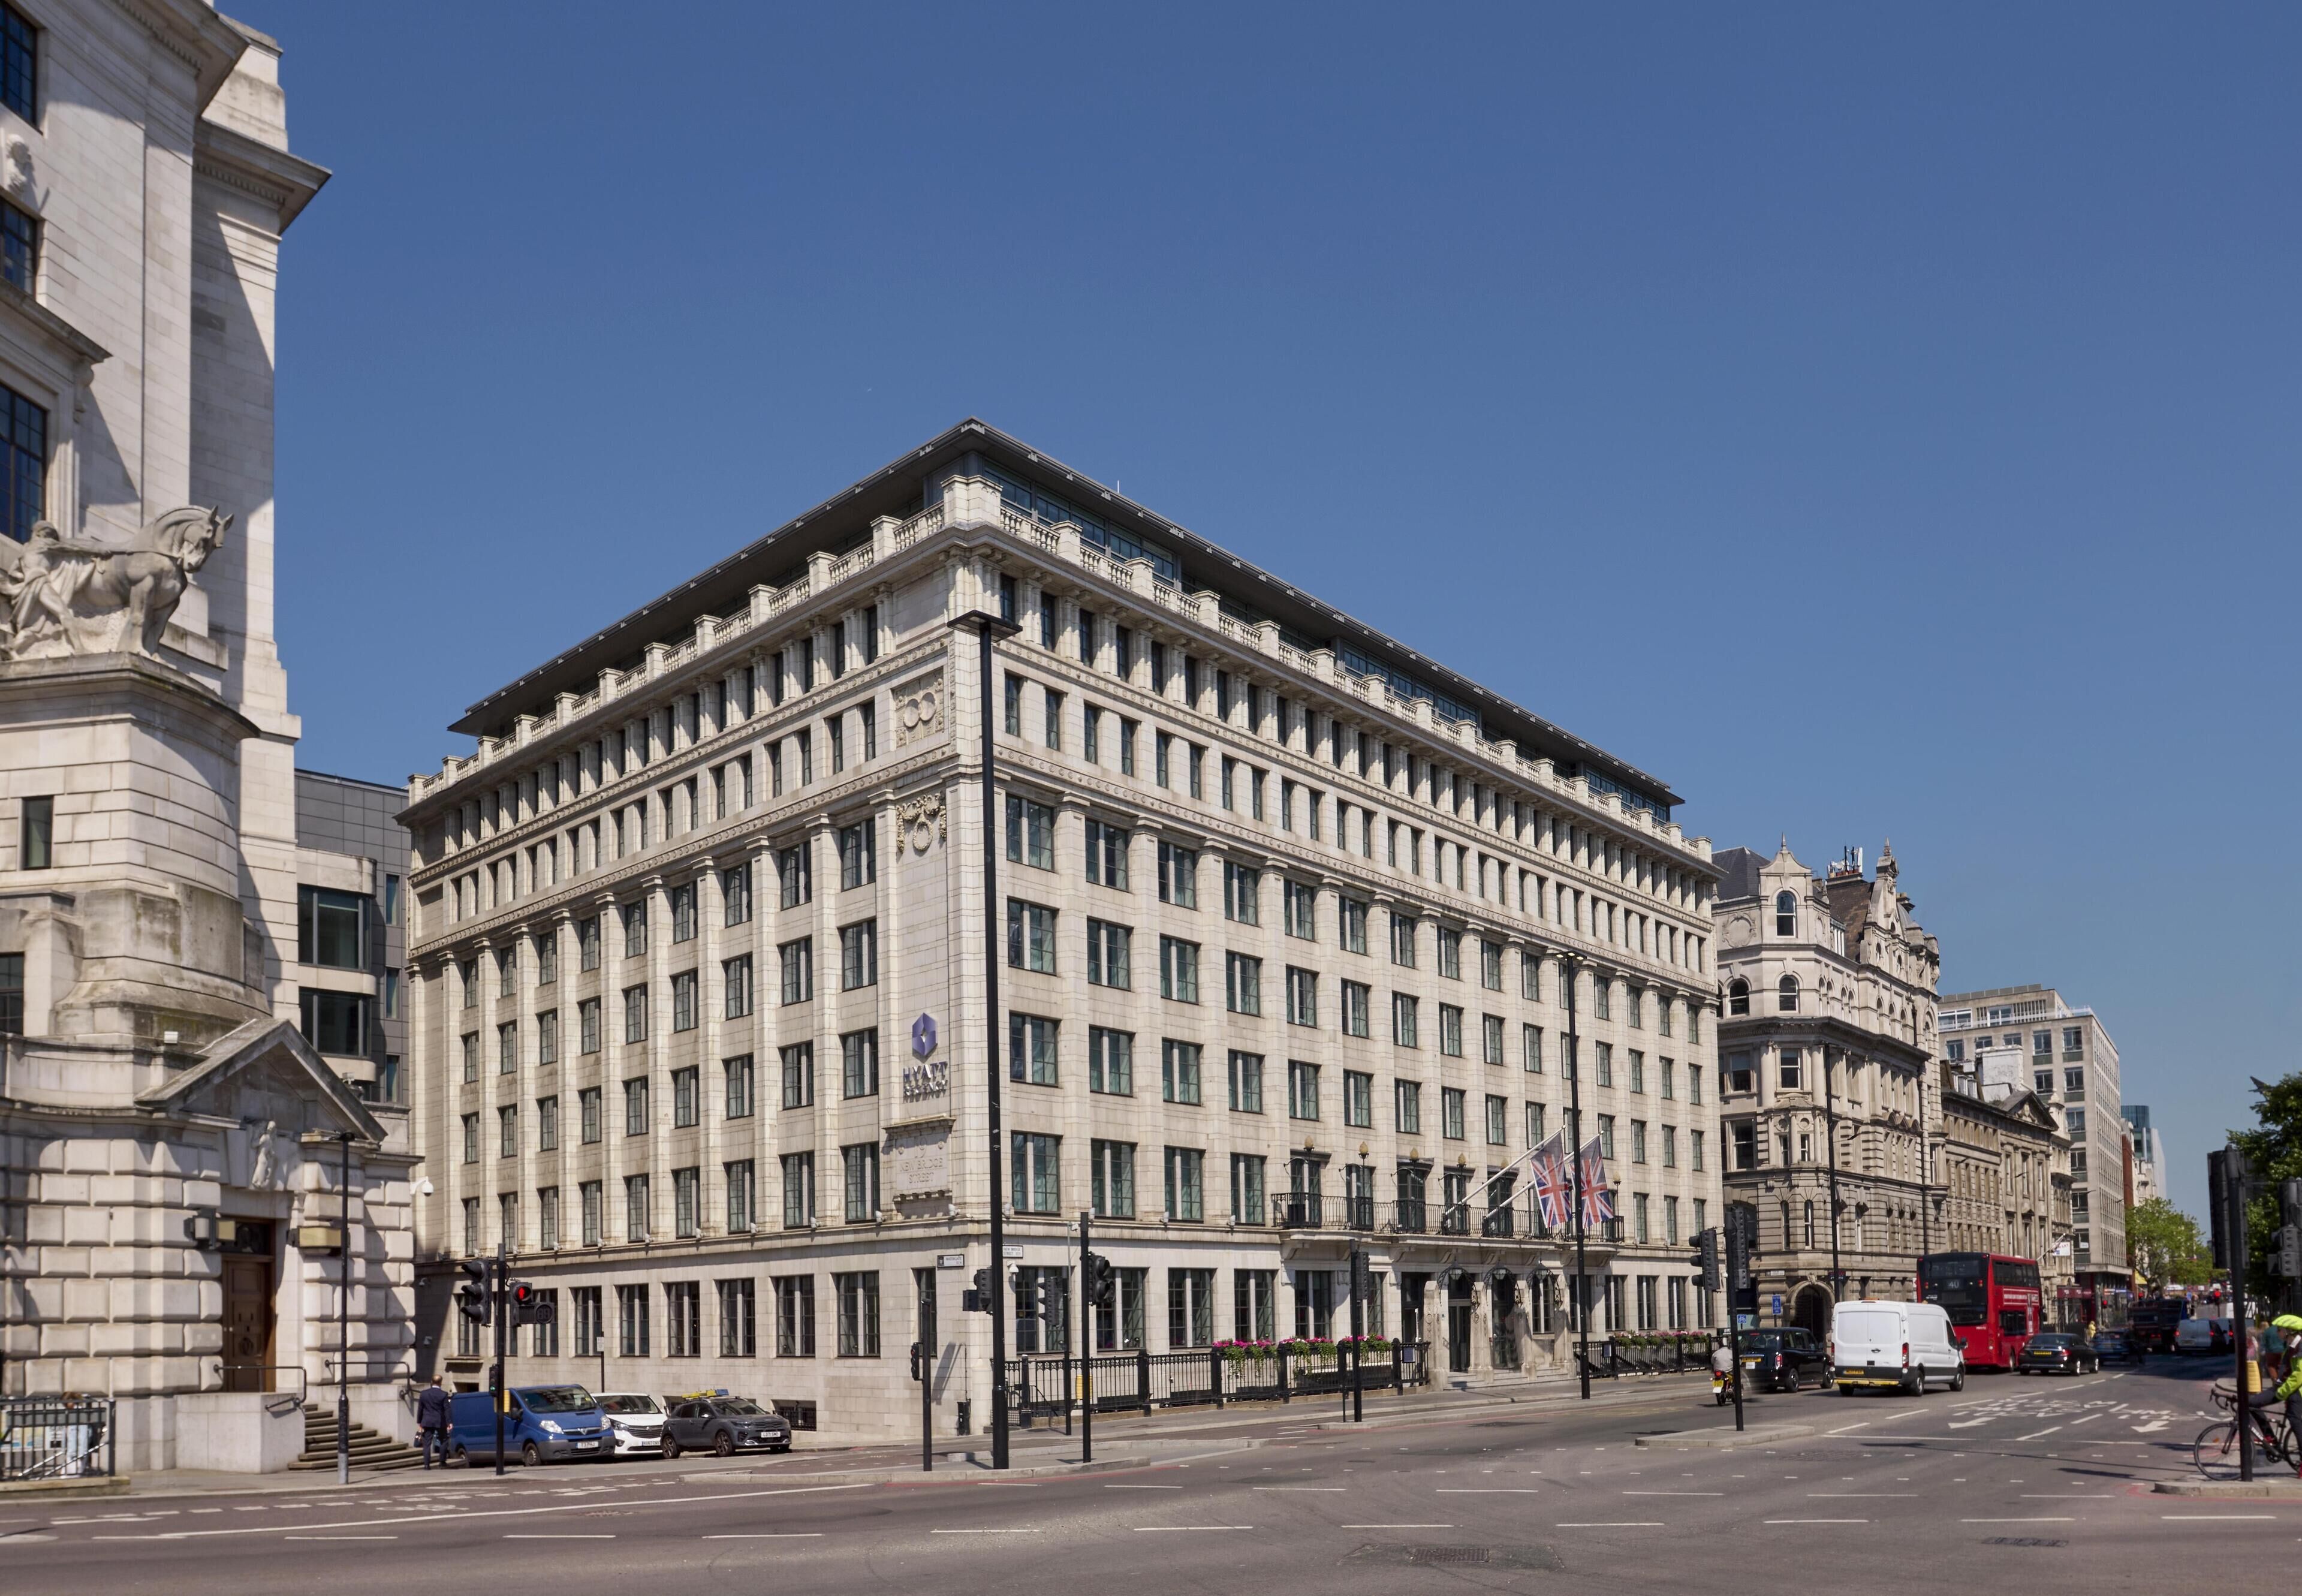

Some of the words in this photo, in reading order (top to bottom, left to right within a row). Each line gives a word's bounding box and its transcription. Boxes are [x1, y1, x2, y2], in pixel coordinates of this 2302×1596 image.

[903, 1062, 947, 1082] HYATT
[917, 1158, 943, 1169] BRIDGE
[909, 1172, 934, 1184] STREET
